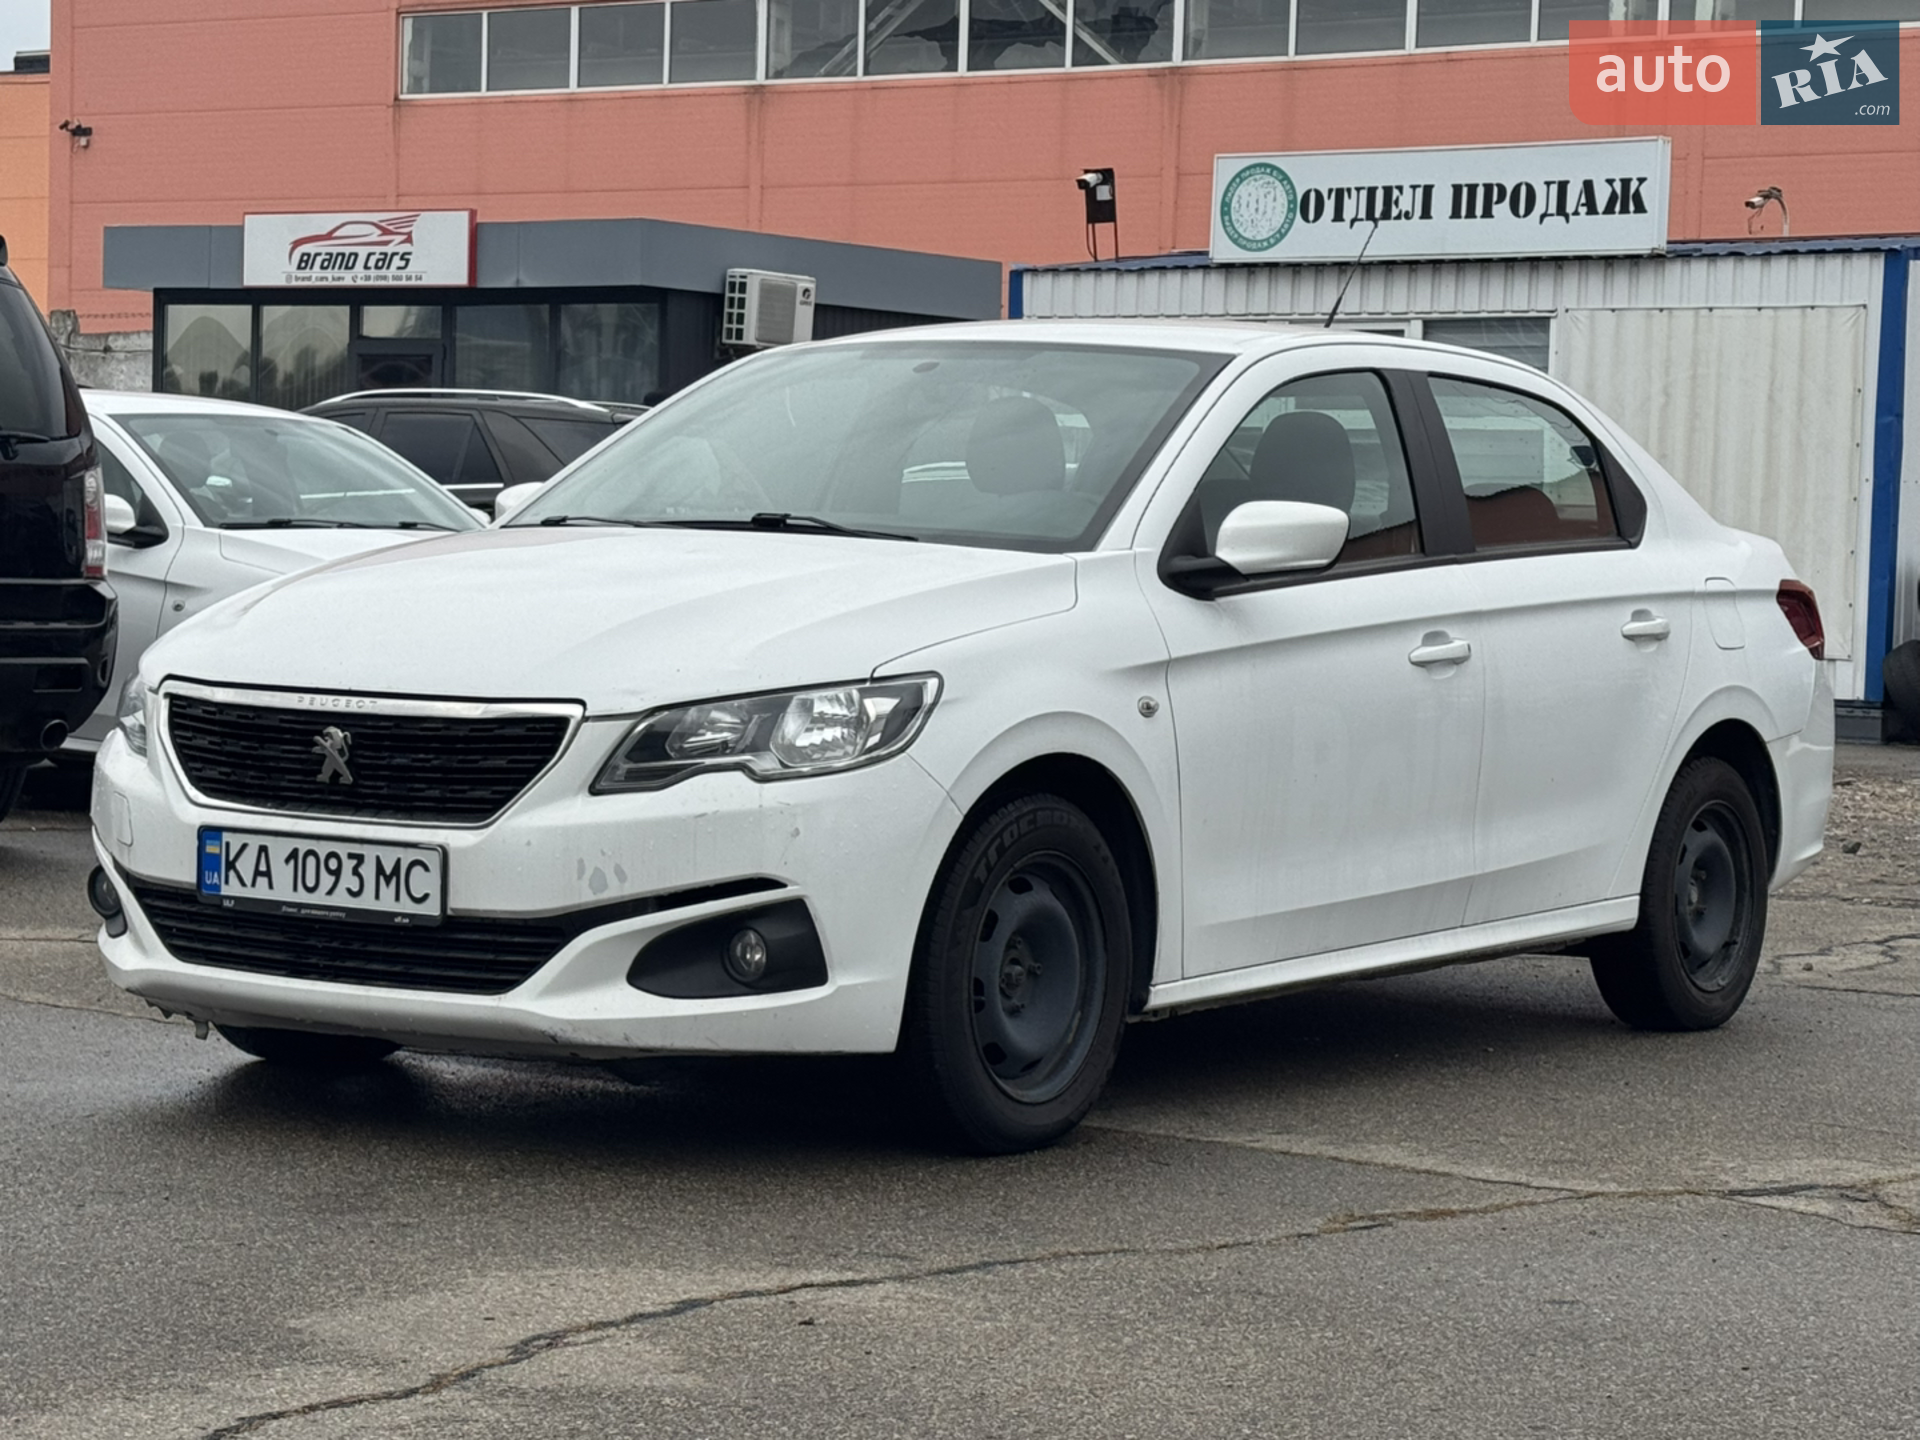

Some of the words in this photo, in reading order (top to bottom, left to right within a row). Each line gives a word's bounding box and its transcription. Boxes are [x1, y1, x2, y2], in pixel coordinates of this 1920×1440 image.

[1240, 166, 1272, 179] ПРОДАЖ
[1282, 180, 1295, 201] АВТО
[1299, 183, 1436, 230] ОТДЕЛ
[1448, 176, 1648, 225] ПРОДАЖ
[297, 695, 378, 709] PEUGEOT
[205, 871, 220, 885] UA
[224, 841, 274, 891] KA
[284, 847, 366, 898] 1093
[375, 854, 431, 905] MC
